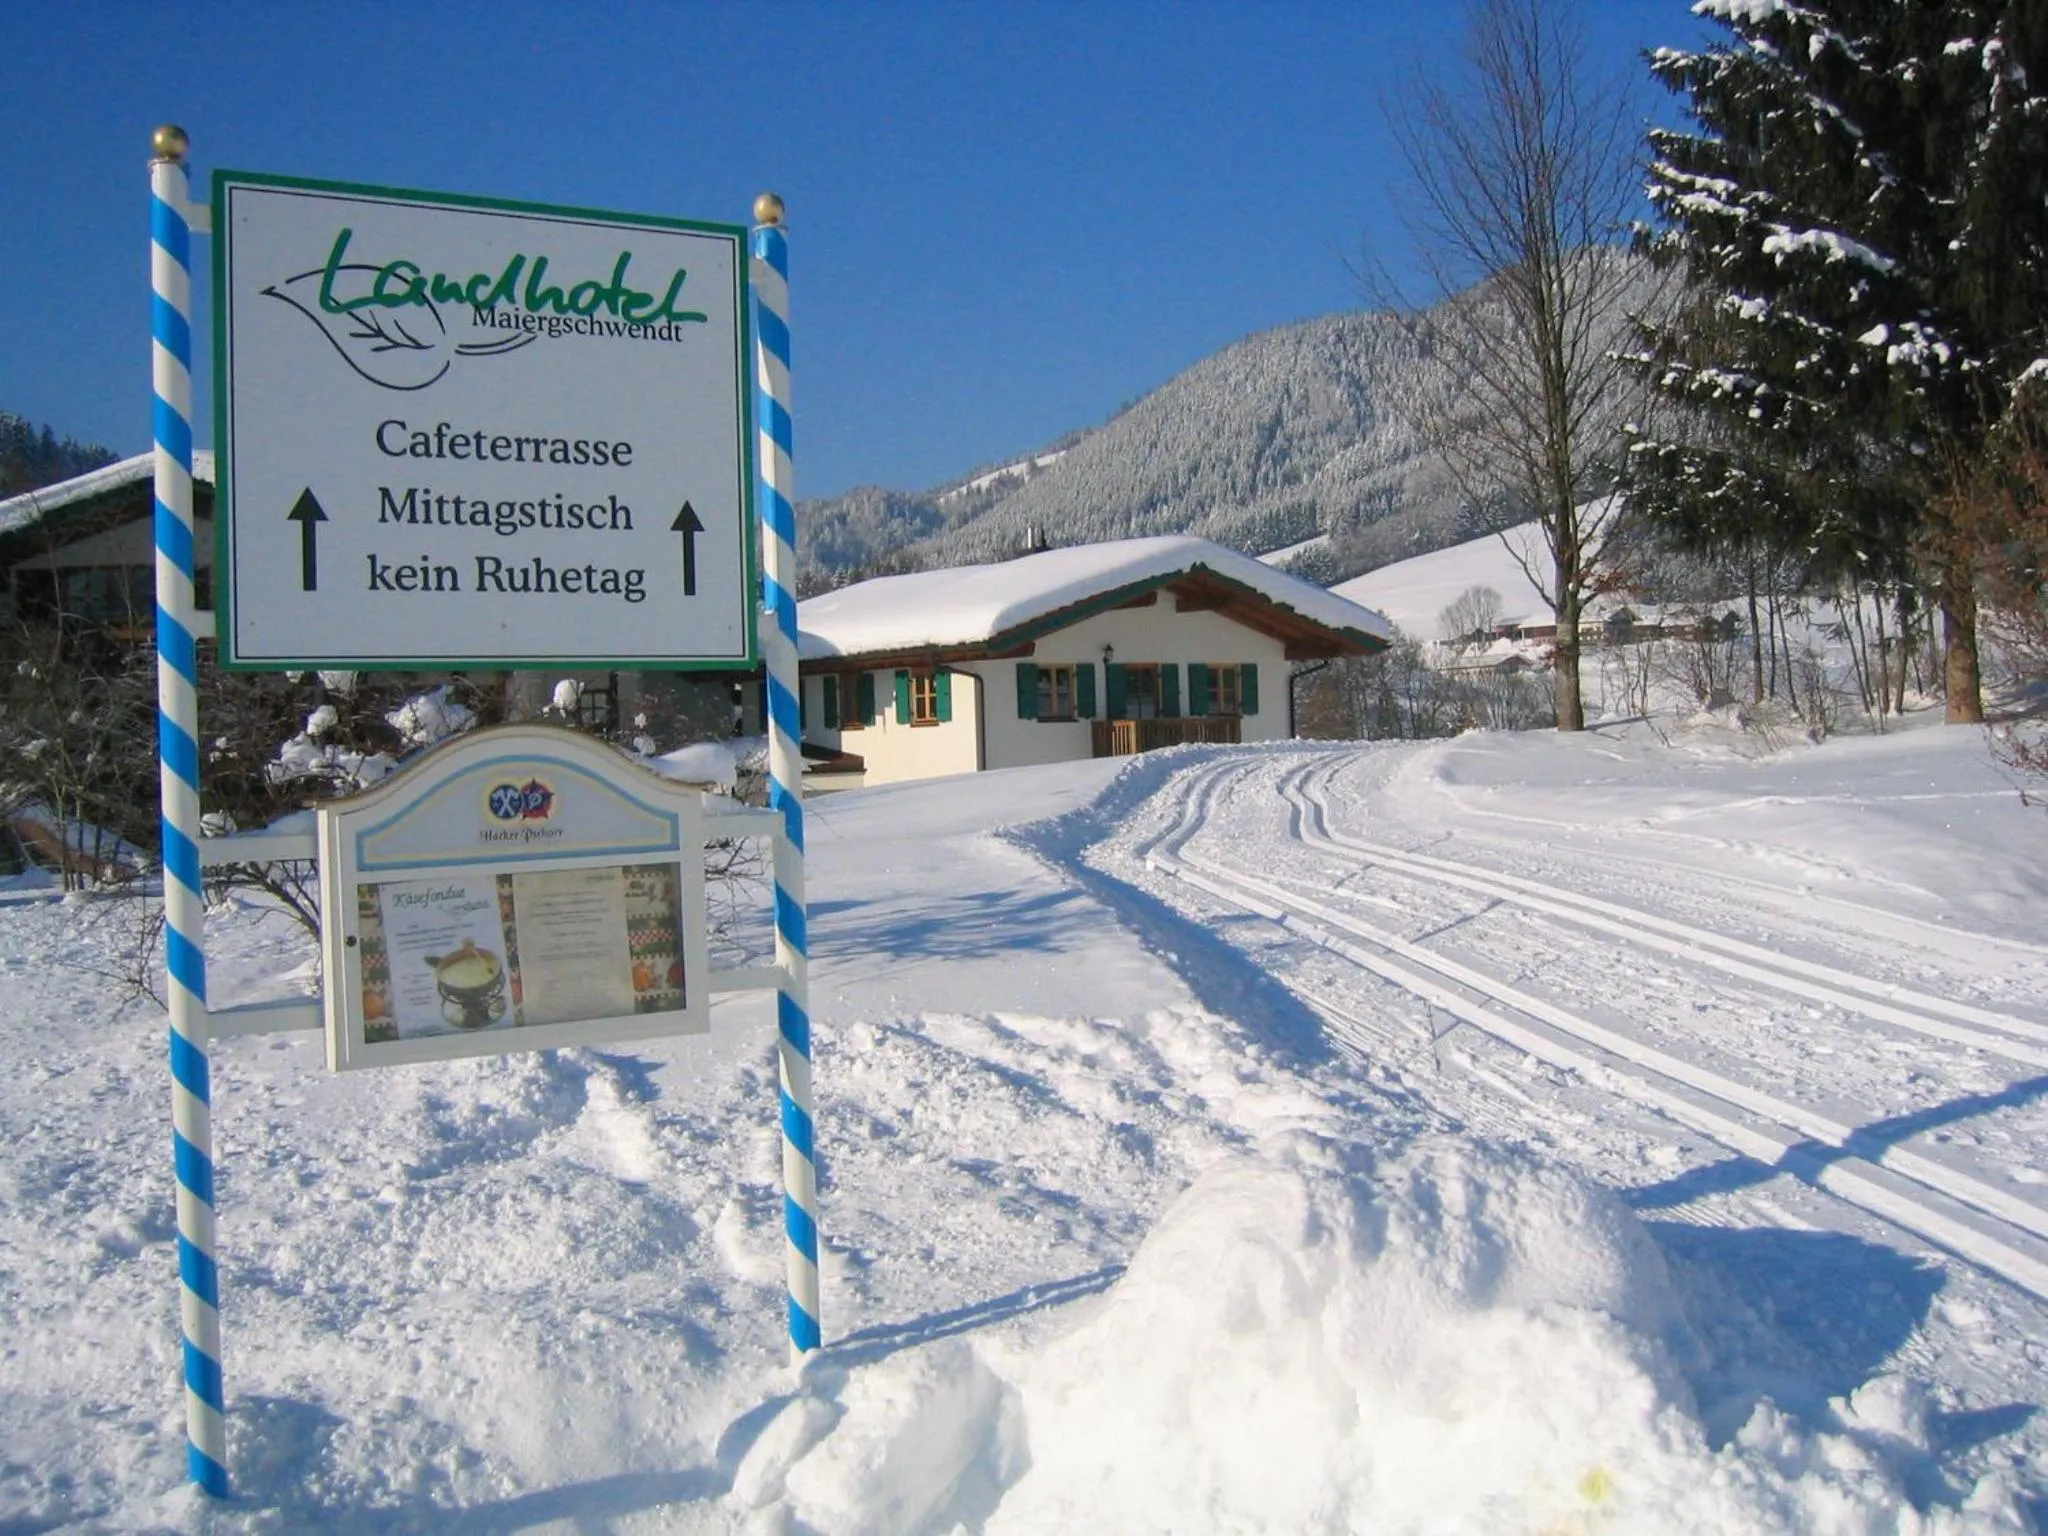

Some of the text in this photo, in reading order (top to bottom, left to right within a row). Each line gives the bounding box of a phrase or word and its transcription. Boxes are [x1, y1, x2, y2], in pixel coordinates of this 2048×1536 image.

[319, 228, 707, 324] Landhotel
[472, 304, 683, 342] Maiergschwendt
[376, 419, 633, 466] Cafeterrasse
[377, 486, 633, 536] Mittagstisch
[366, 553, 647, 602] kein Ruhetag
